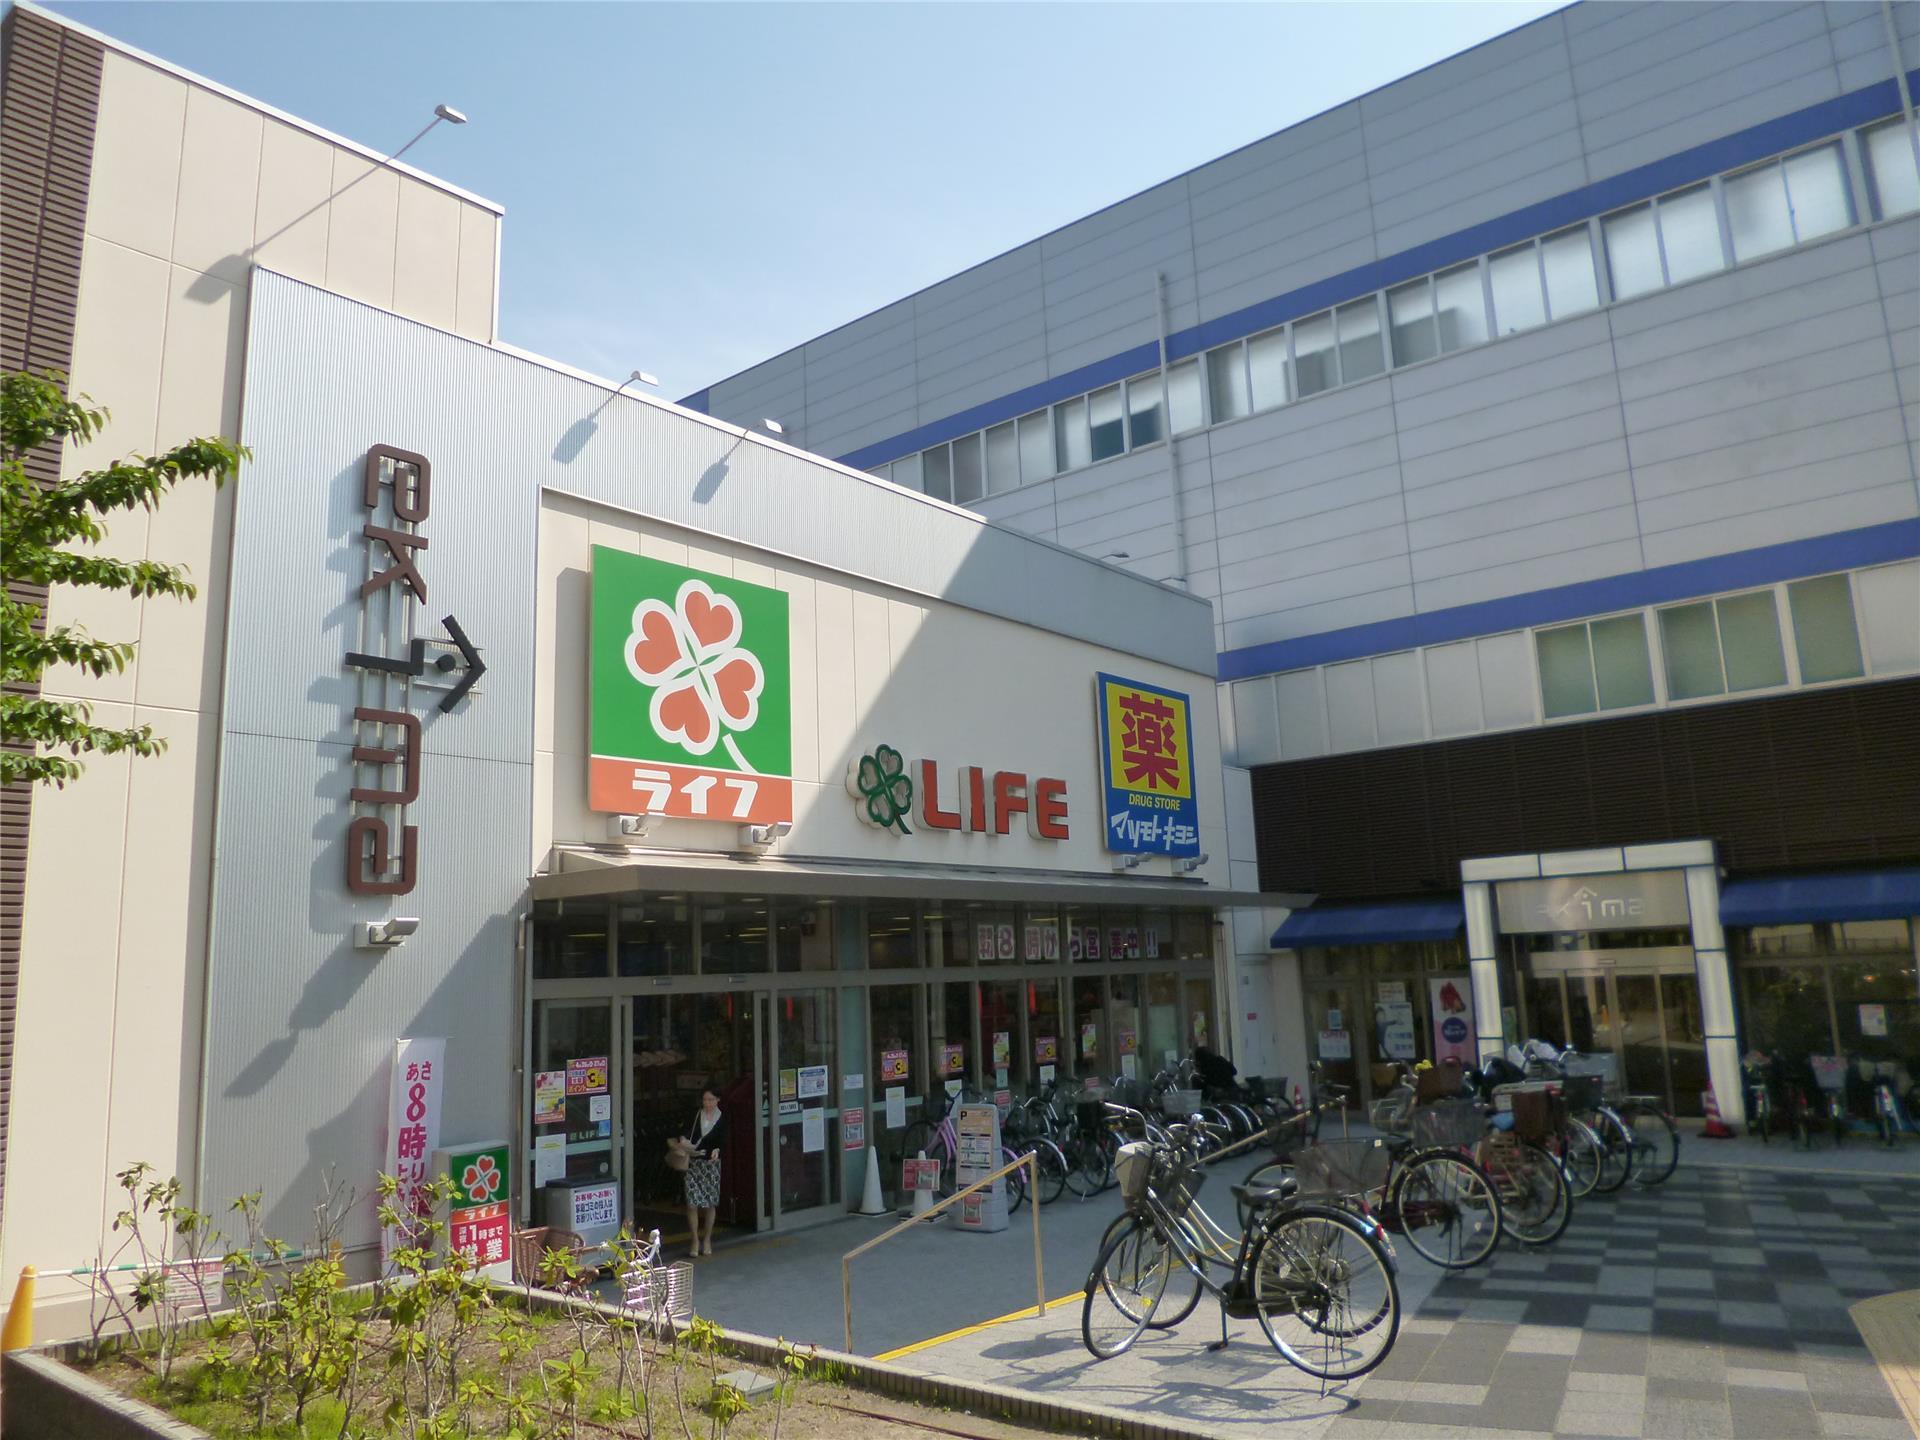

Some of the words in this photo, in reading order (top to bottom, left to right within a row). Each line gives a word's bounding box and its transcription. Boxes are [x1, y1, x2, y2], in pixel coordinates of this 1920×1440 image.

[1119, 692, 1181, 791] 薬
[632, 767, 760, 819] ライフ
[912, 758, 1070, 841] LIFE
[1128, 793, 1153, 808] DRUG
[1154, 797, 1181, 811] STORE
[464, 1204, 500, 1220] ライフ
